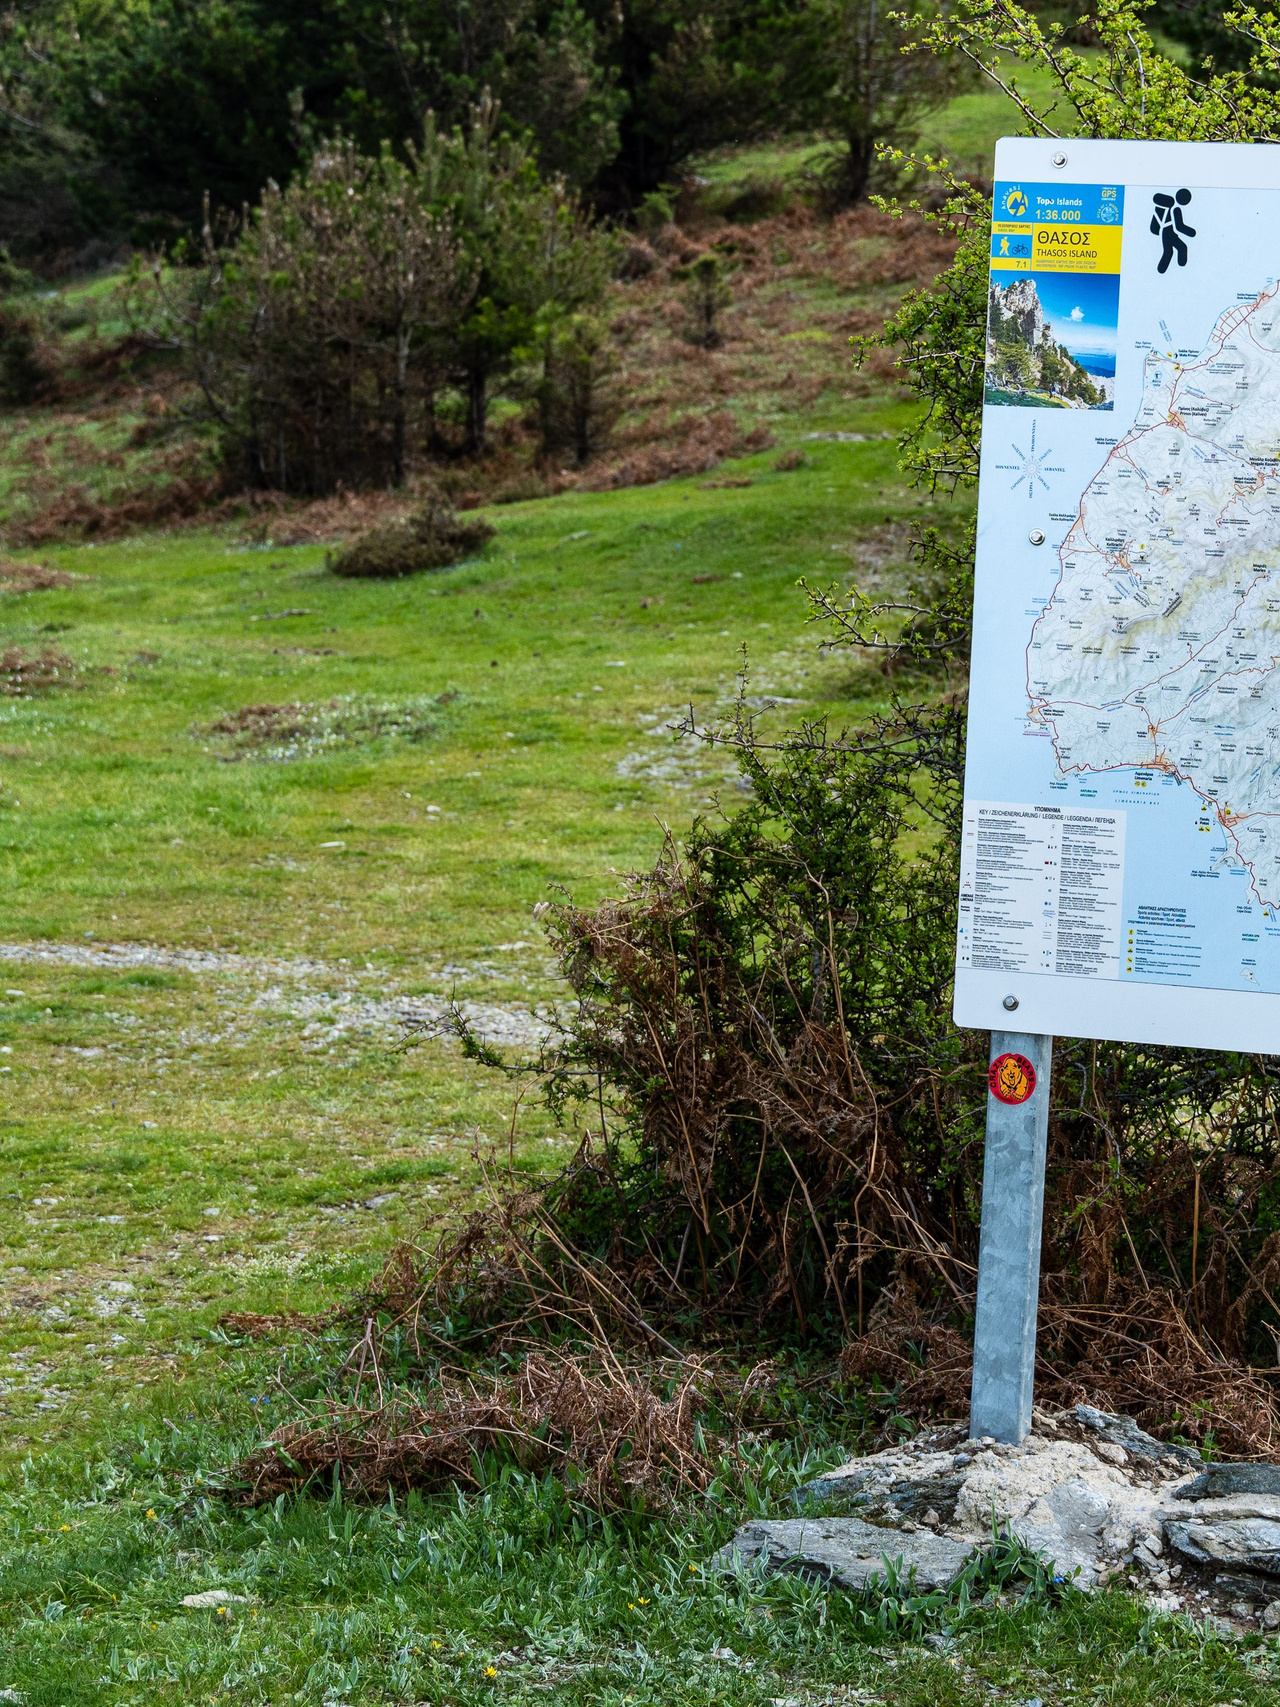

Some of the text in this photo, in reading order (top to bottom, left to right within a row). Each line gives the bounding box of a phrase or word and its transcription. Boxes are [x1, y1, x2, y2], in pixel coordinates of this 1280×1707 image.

[1101, 190, 1116, 198] GPS
[1037, 197, 1082, 206] Topo Islands
[1036, 209, 1081, 220] 1:36.000
[1037, 230, 1090, 245] ΘΑΣΟΣ
[1037, 249, 1097, 258] THASOS ISLAND
[1017, 1057, 1034, 1082] BEARS
